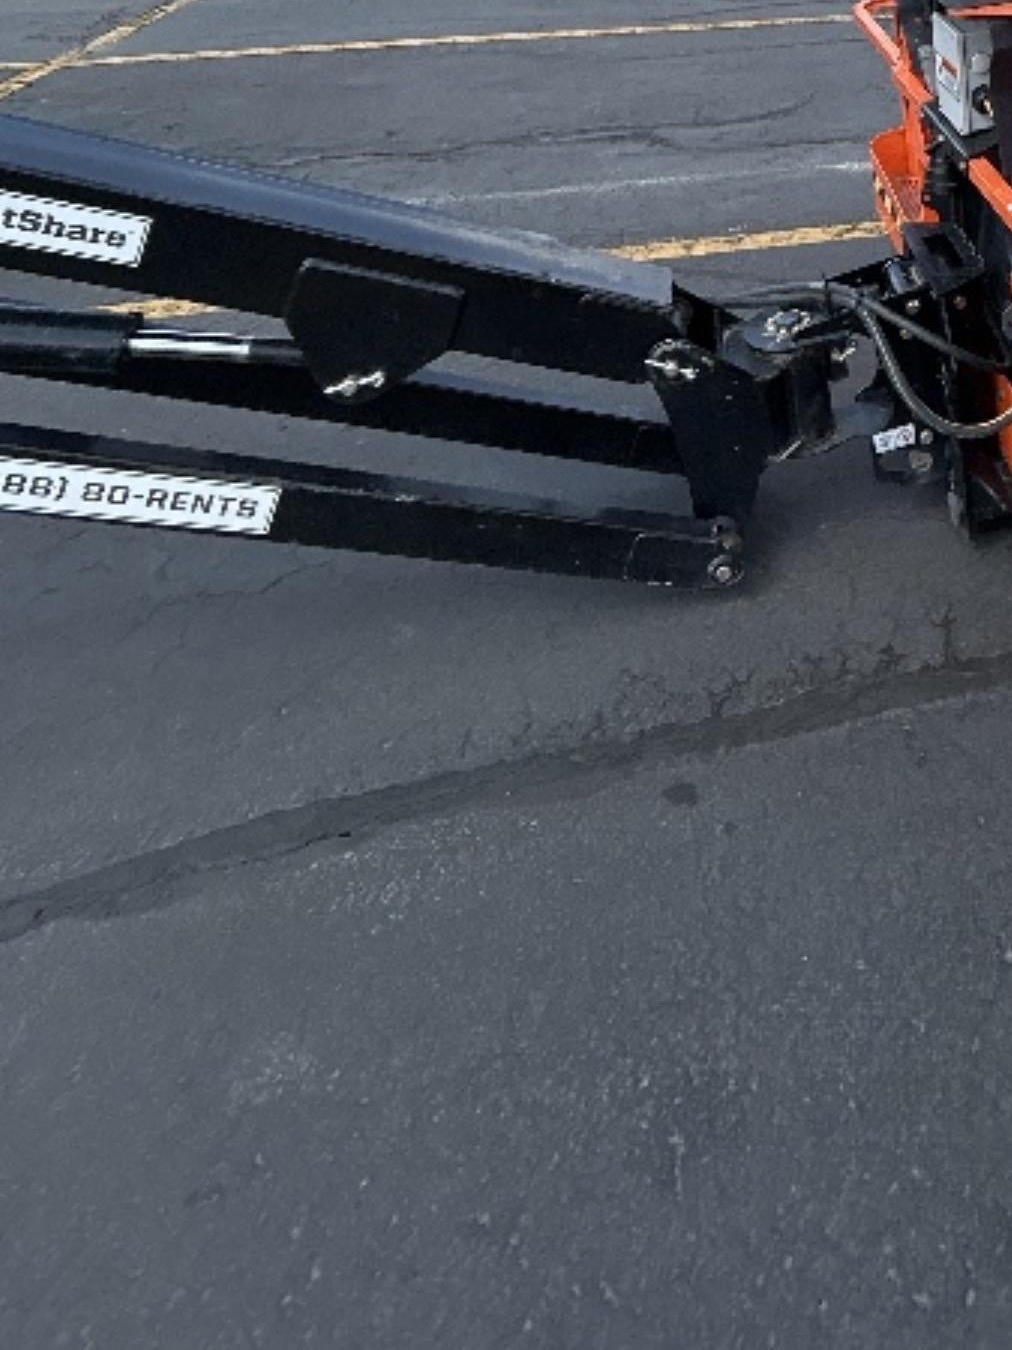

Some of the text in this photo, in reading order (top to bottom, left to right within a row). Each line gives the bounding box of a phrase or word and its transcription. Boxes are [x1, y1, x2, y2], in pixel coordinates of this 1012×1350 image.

[2, 208, 127, 248] tShare
[2, 473, 259, 518] 88) 80-RENTS
